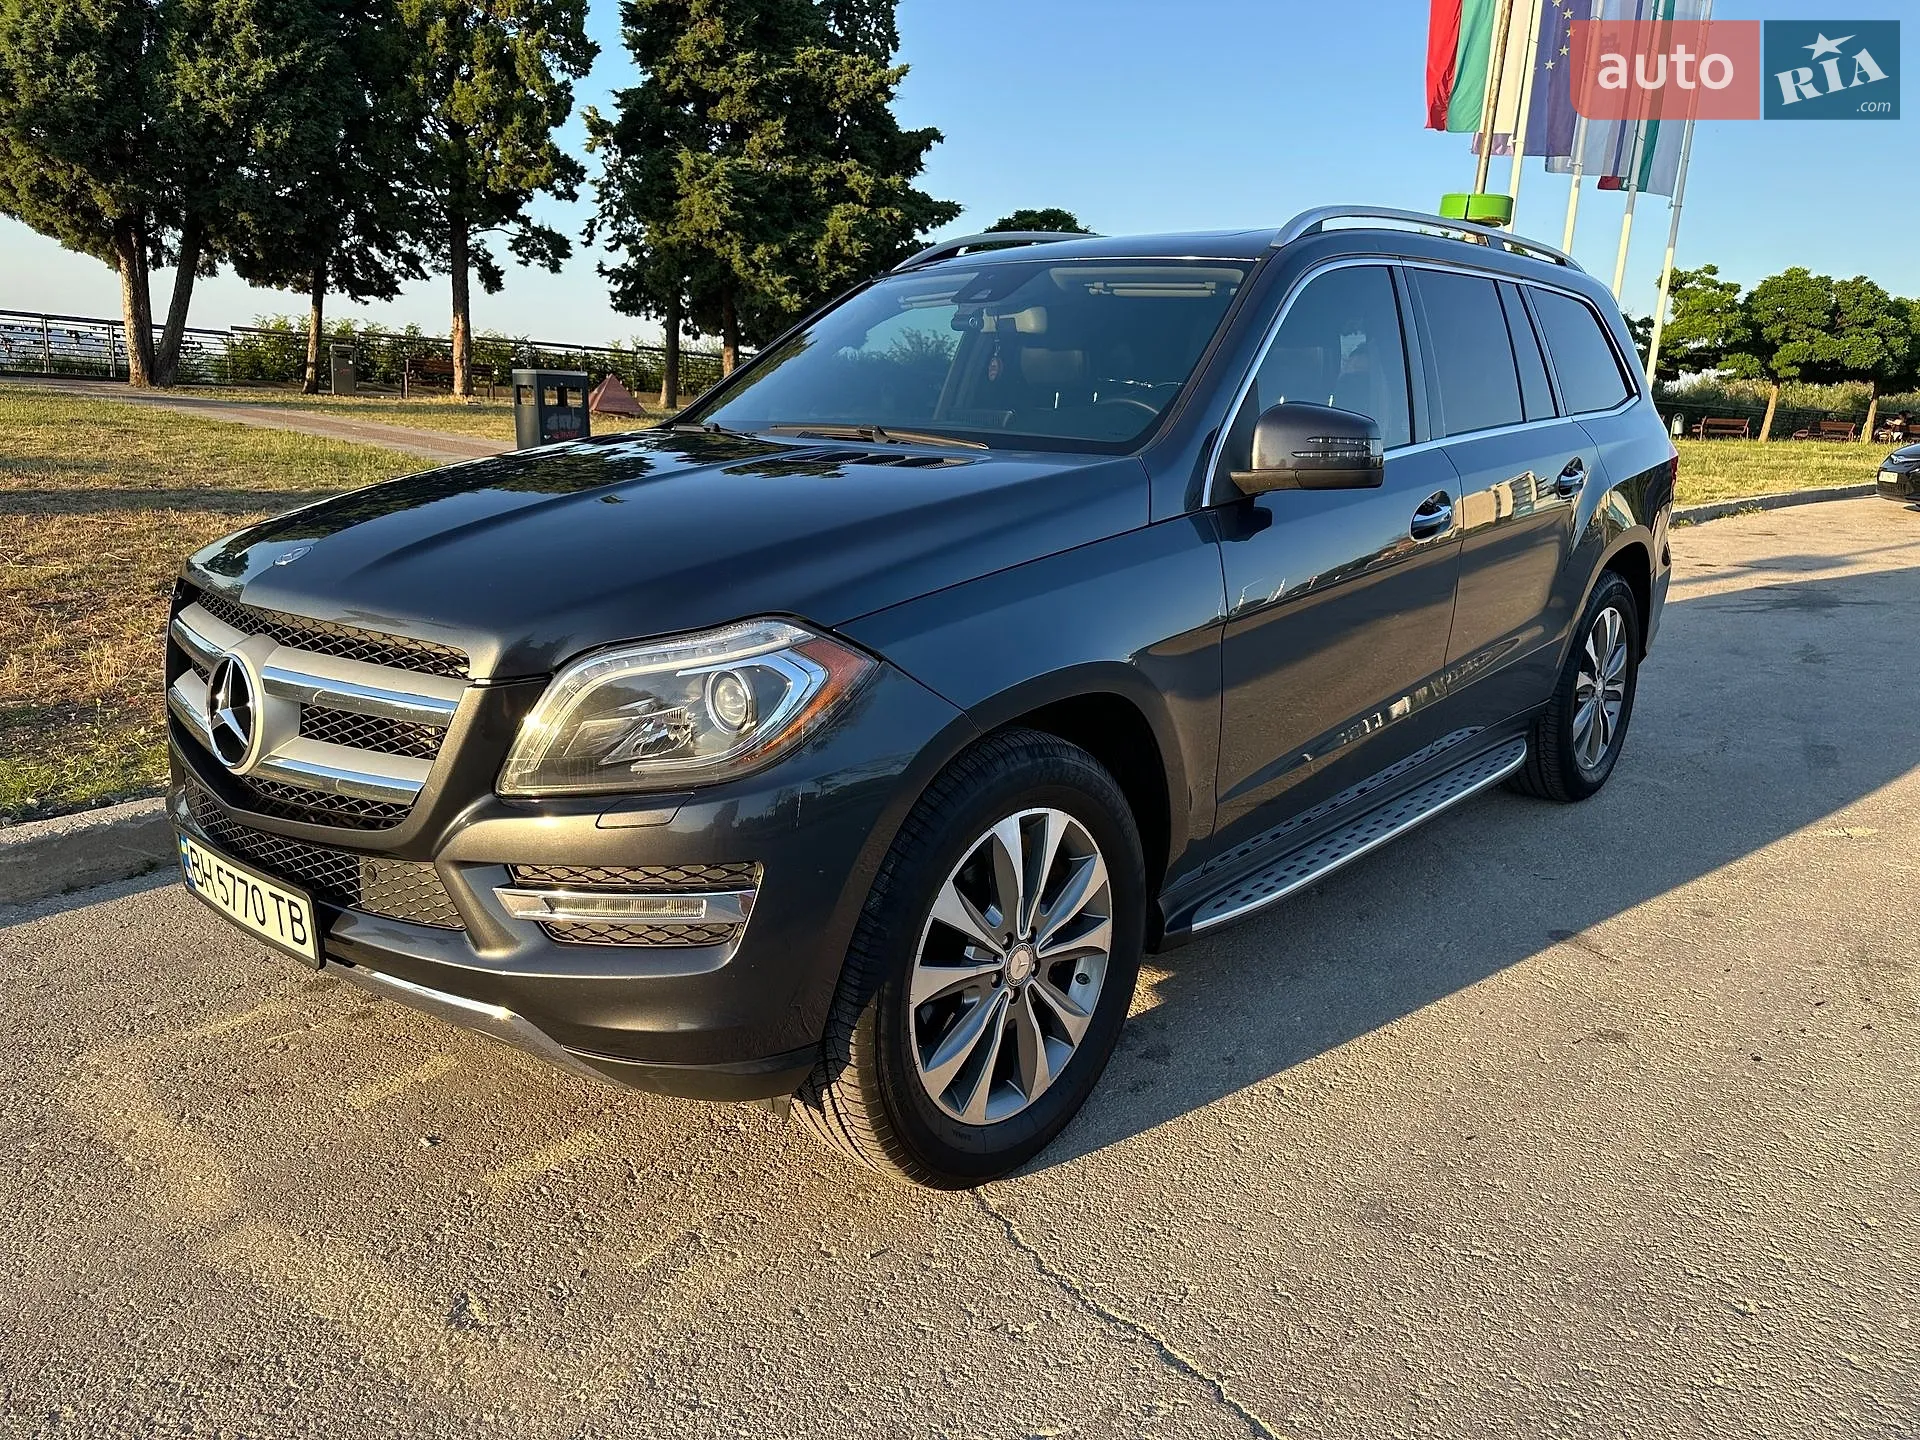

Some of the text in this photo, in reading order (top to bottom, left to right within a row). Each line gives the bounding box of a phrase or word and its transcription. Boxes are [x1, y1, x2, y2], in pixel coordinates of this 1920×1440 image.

[189, 846, 307, 946] BH 5770 TB
